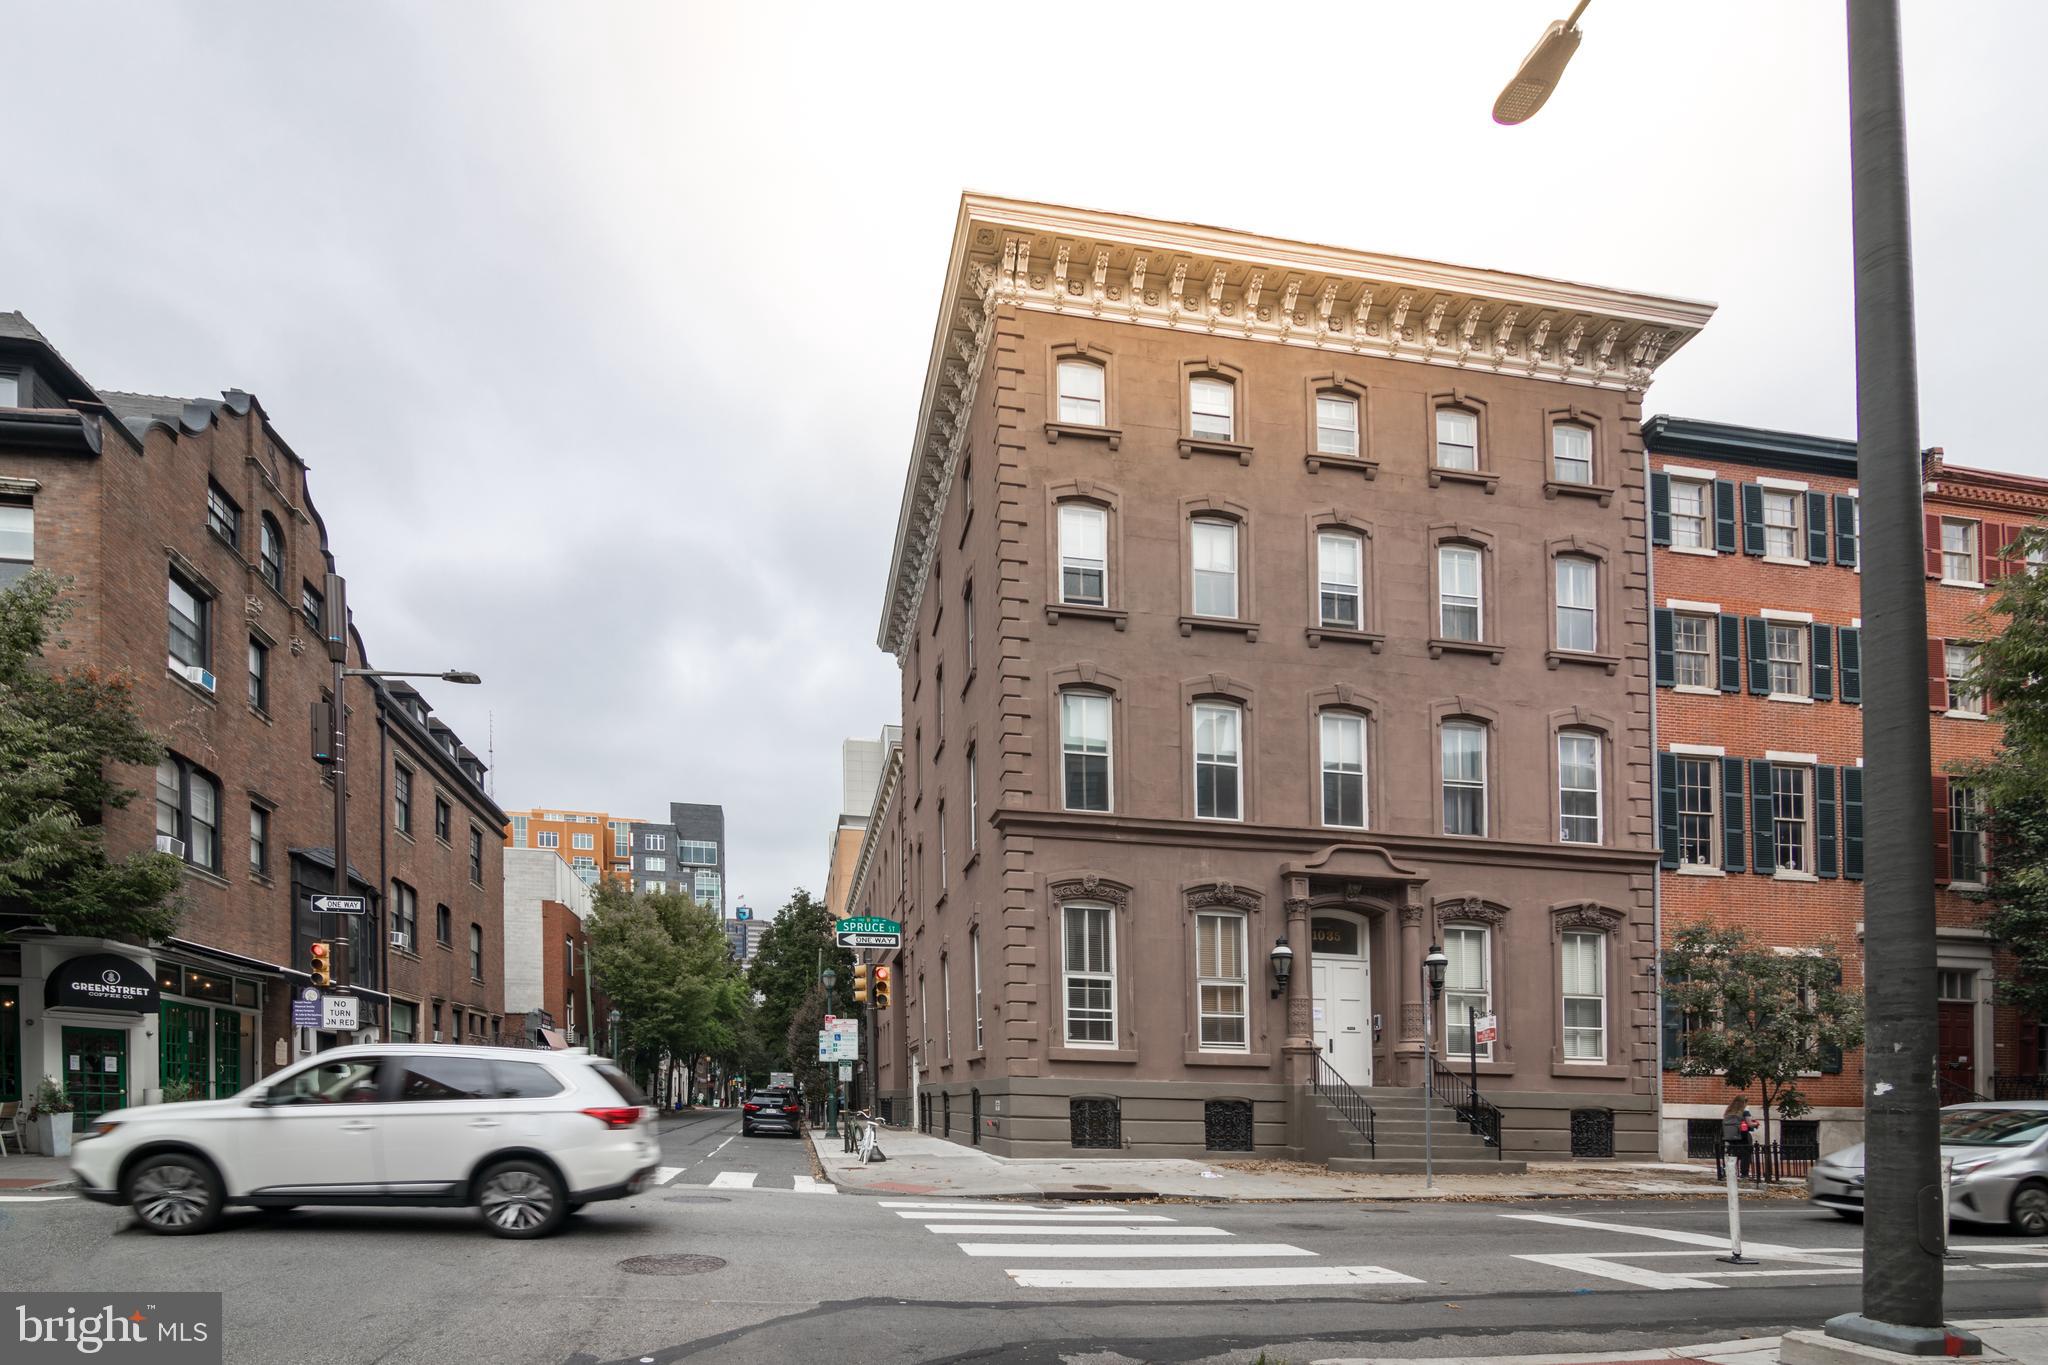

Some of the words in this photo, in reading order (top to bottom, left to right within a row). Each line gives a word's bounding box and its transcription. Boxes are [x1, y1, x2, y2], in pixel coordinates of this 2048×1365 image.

[344, 901, 359, 909] WAY
[843, 922, 885, 932] SPRUCE
[71, 982, 150, 996] GREENSTREET
[88, 991, 121, 999] COFFEE
[330, 1009, 351, 1017] TURN
